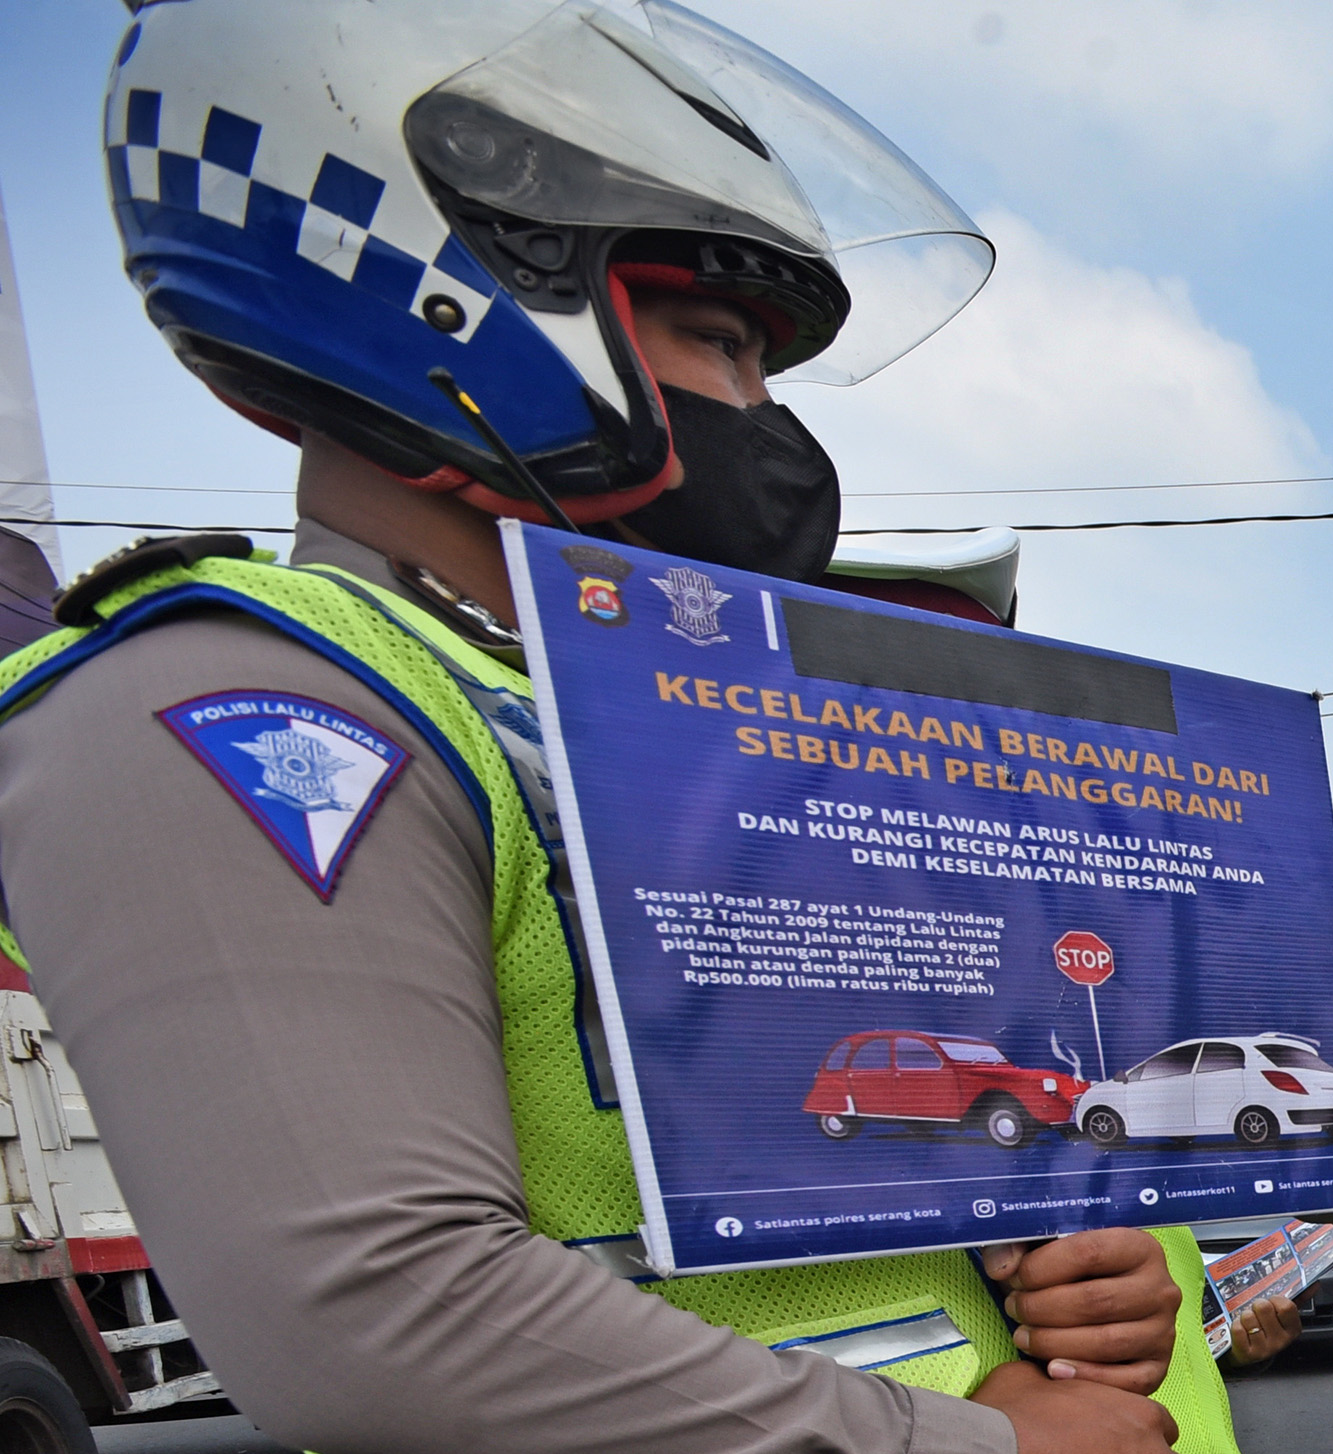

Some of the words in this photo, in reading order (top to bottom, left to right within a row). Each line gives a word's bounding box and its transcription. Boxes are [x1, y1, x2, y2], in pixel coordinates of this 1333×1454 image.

[190, 702, 258, 724] POLISI
[263, 701, 315, 720] LALU
[319, 713, 388, 756] LINTAS
[655, 671, 984, 751] KECELAKAAN
[998, 728, 1186, 781] BERAWAL
[1192, 761, 1270, 796] DARI
[735, 726, 931, 780] SEBUAH
[945, 757, 1243, 824] PELANGGARAN!
[805, 799, 874, 821] STOP
[881, 808, 1011, 838] MELAWAN
[1019, 824, 1080, 844] ARUS
[1083, 832, 1141, 851] LALU
[1148, 838, 1214, 860] LINTAS
[737, 812, 800, 835] DAN
[808, 821, 932, 849] KURANGI
[941, 836, 1076, 863] KECEPATAN
[1082, 851, 1206, 879] KENDARAAN
[1212, 866, 1265, 885] ANDA
[851, 848, 917, 869] DEMI
[923, 853, 1096, 886] KESELAMATAN
[1101, 874, 1197, 895] BERSAMA
[633, 887, 707, 904] Sesuai
[712, 893, 764, 908] Pasal
[768, 898, 801, 911] 287
[807, 902, 849, 916] ayat
[854, 905, 863, 916] 1
[868, 906, 1005, 929] Undang-Undang
[645, 904, 685, 918] No.
[690, 907, 715, 920] 22
[719, 909, 780, 925] Tahun
[784, 914, 829, 928] 2009
[833, 918, 907, 936] tentang
[910, 922, 946, 936] Lalu
[950, 925, 1001, 940] Lintas
[656, 921, 698, 935] dan
[703, 923, 800, 942] Angkutan
[804, 931, 851, 945] Jalan
[856, 933, 934, 949] dipidana
[938, 938, 999, 954] dengan
[661, 937, 732, 953] pidana
[737, 942, 832, 960] kurungan
[838, 949, 893, 964] paling
[897, 951, 941, 963] lama
[945, 953, 955, 965] 2
[957, 954, 1001, 969] (dua)
[689, 954, 745, 969] bulan
[750, 959, 796, 972] atau
[801, 961, 859, 975] denda
[863, 965, 920, 980] paling
[923, 966, 985, 982] banyak
[1058, 948, 1111, 970] STOP
[683, 970, 783, 986] Rp500.000
[787, 974, 836, 989] (lima
[841, 978, 889, 990] ratus
[893, 979, 930, 992] ribu
[934, 983, 995, 996] rupiah)
[1165, 1186, 1236, 1199] Lantasserkot11
[1278, 1181, 1291, 1190] Sat
[1293, 1179, 1320, 1188] lantas
[754, 1215, 820, 1231] Satlantas
[824, 1212, 865, 1227] polres
[868, 1210, 912, 1223] serang
[914, 1207, 942, 1219] kota
[1001, 1195, 1112, 1212] Satlantasserangkota
